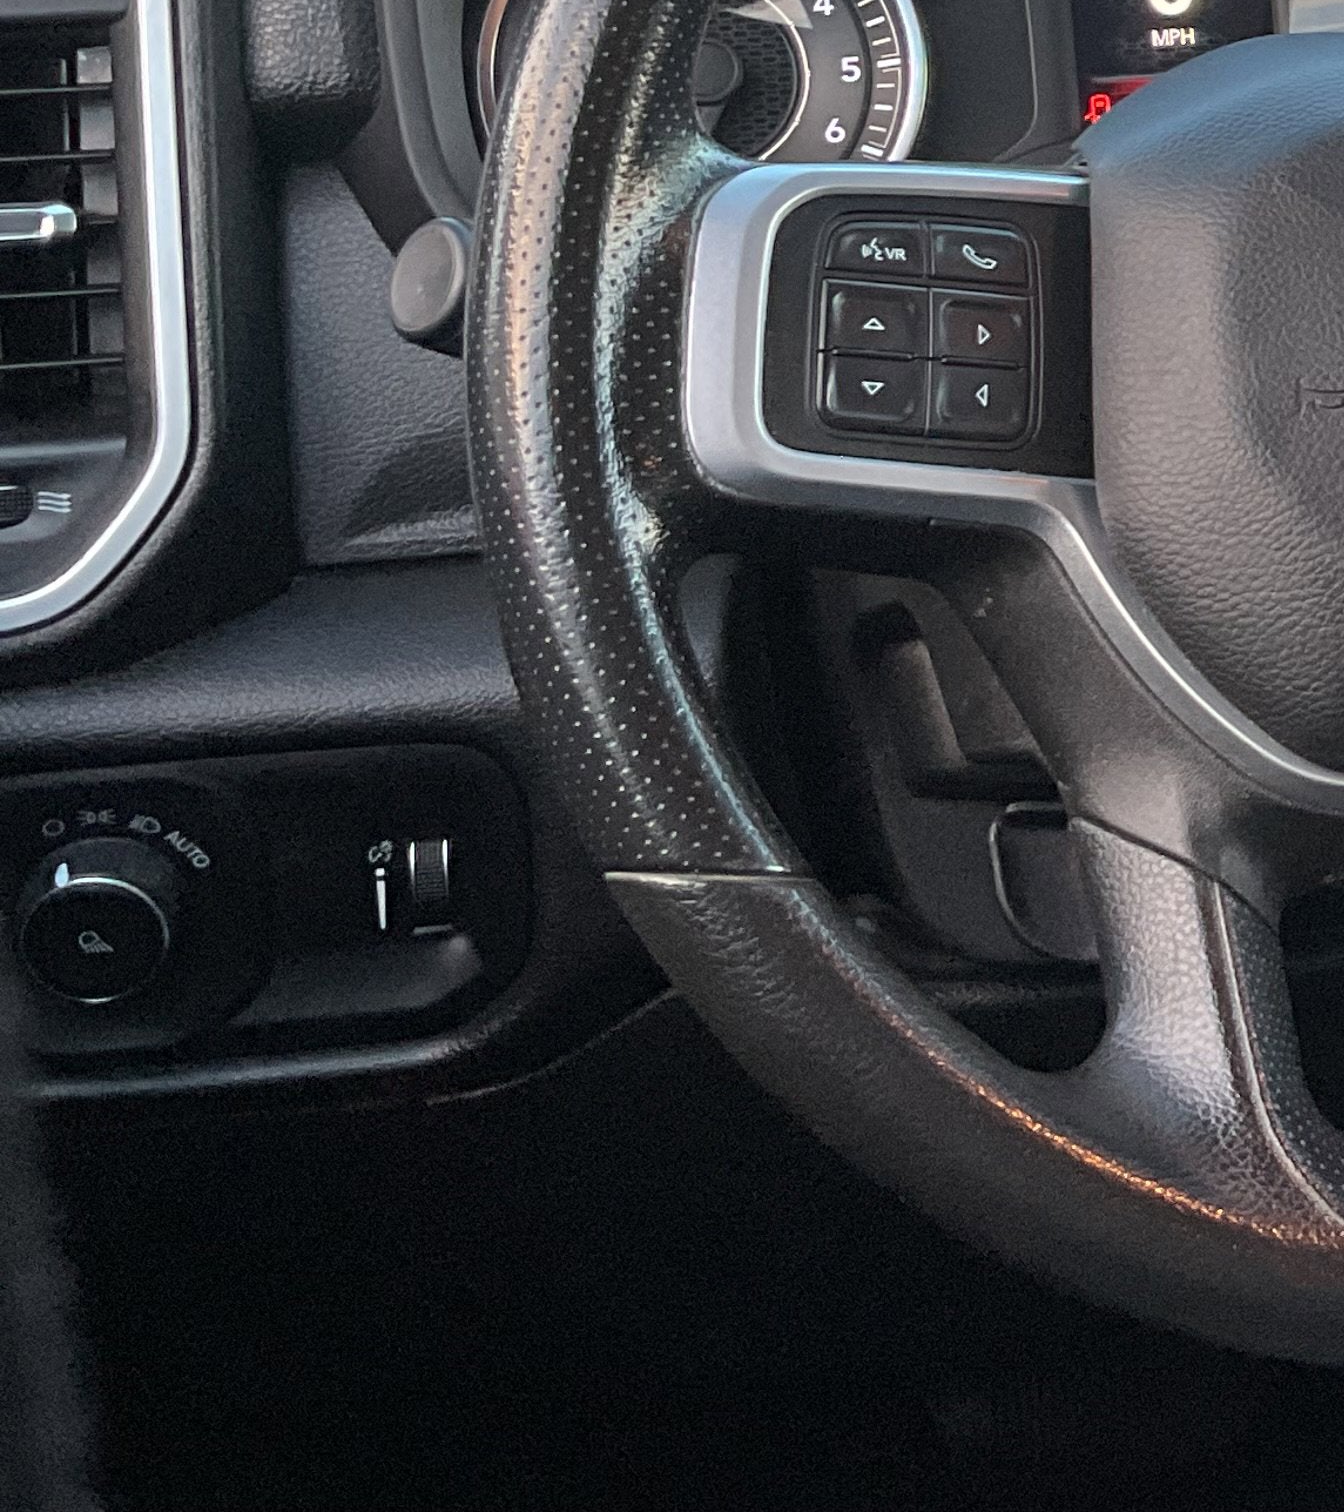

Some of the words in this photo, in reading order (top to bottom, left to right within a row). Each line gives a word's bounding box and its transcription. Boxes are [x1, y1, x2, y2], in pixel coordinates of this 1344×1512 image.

[1151, 27, 1196, 47] MPH
[840, 56, 862, 82] 5
[824, 117, 846, 143] 6
[885, 246, 907, 261] VR
[163, 830, 210, 869] AUTO
